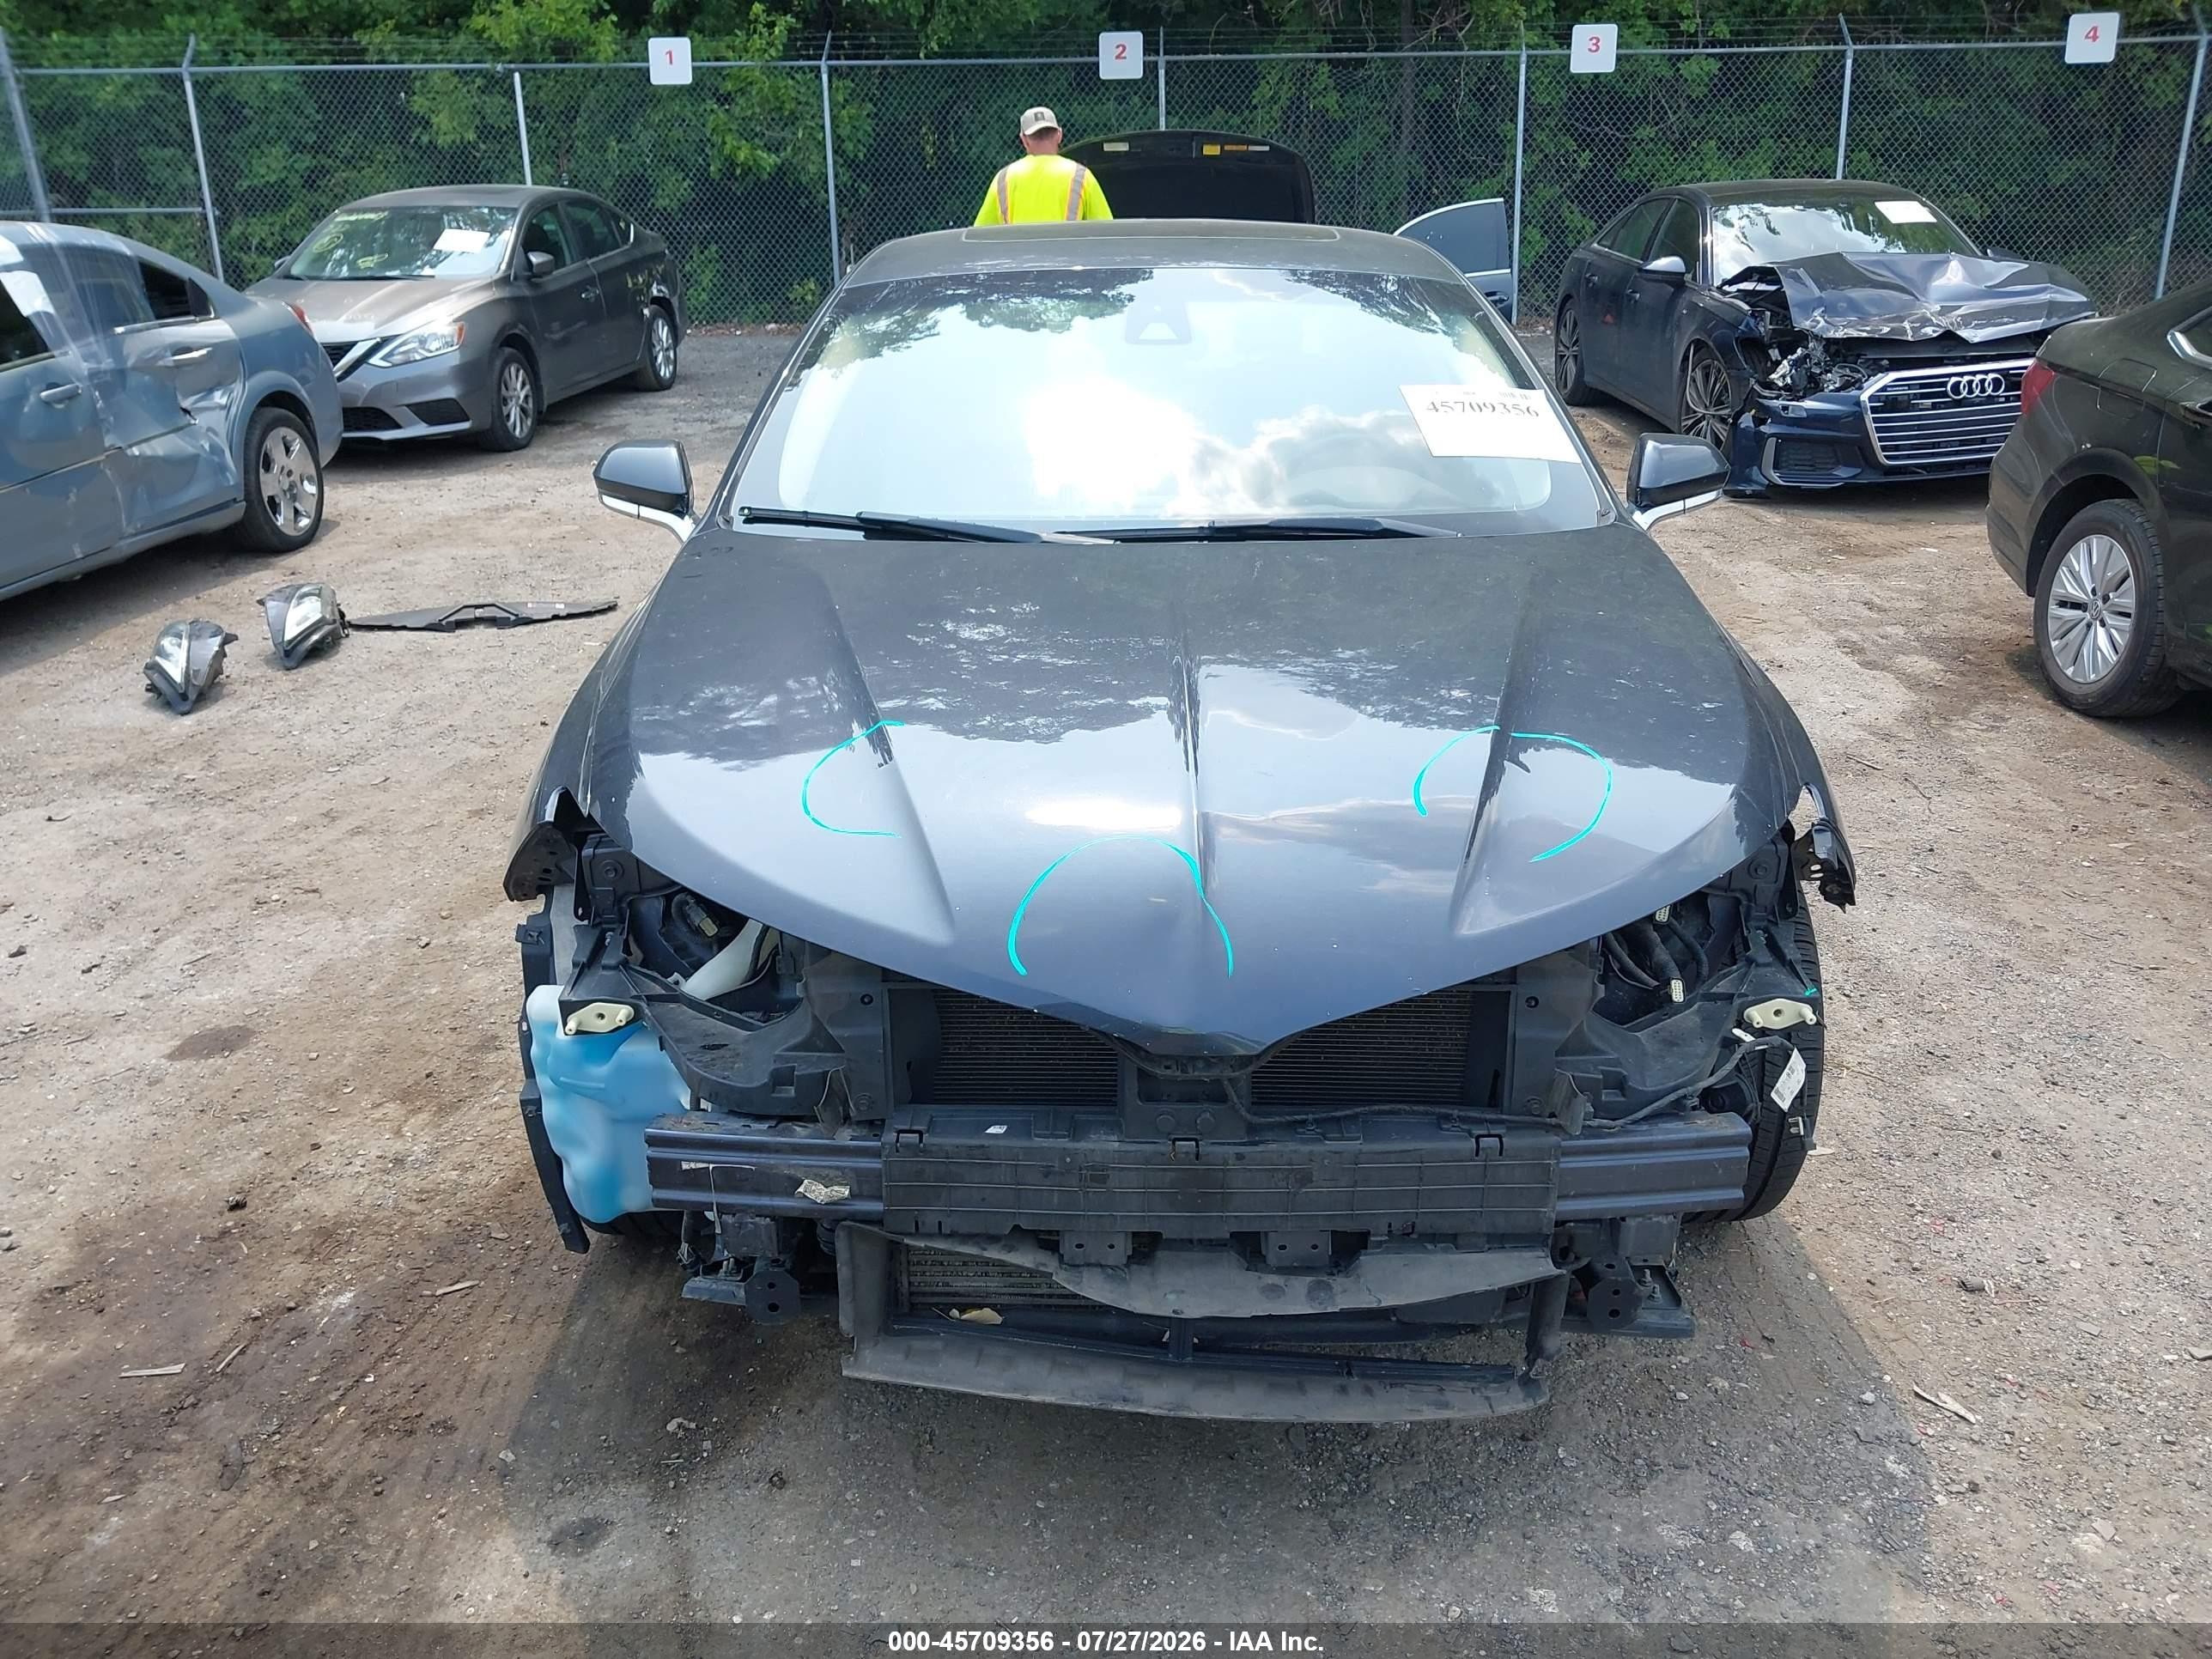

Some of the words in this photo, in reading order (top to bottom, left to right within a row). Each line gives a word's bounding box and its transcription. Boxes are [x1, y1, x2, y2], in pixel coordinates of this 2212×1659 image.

[2084, 26, 2100, 42] 4
[1115, 44, 1127, 60] 2
[1588, 36, 1601, 53] 3
[665, 50, 673, 65] 1
[1426, 400, 1540, 417] 45709356
